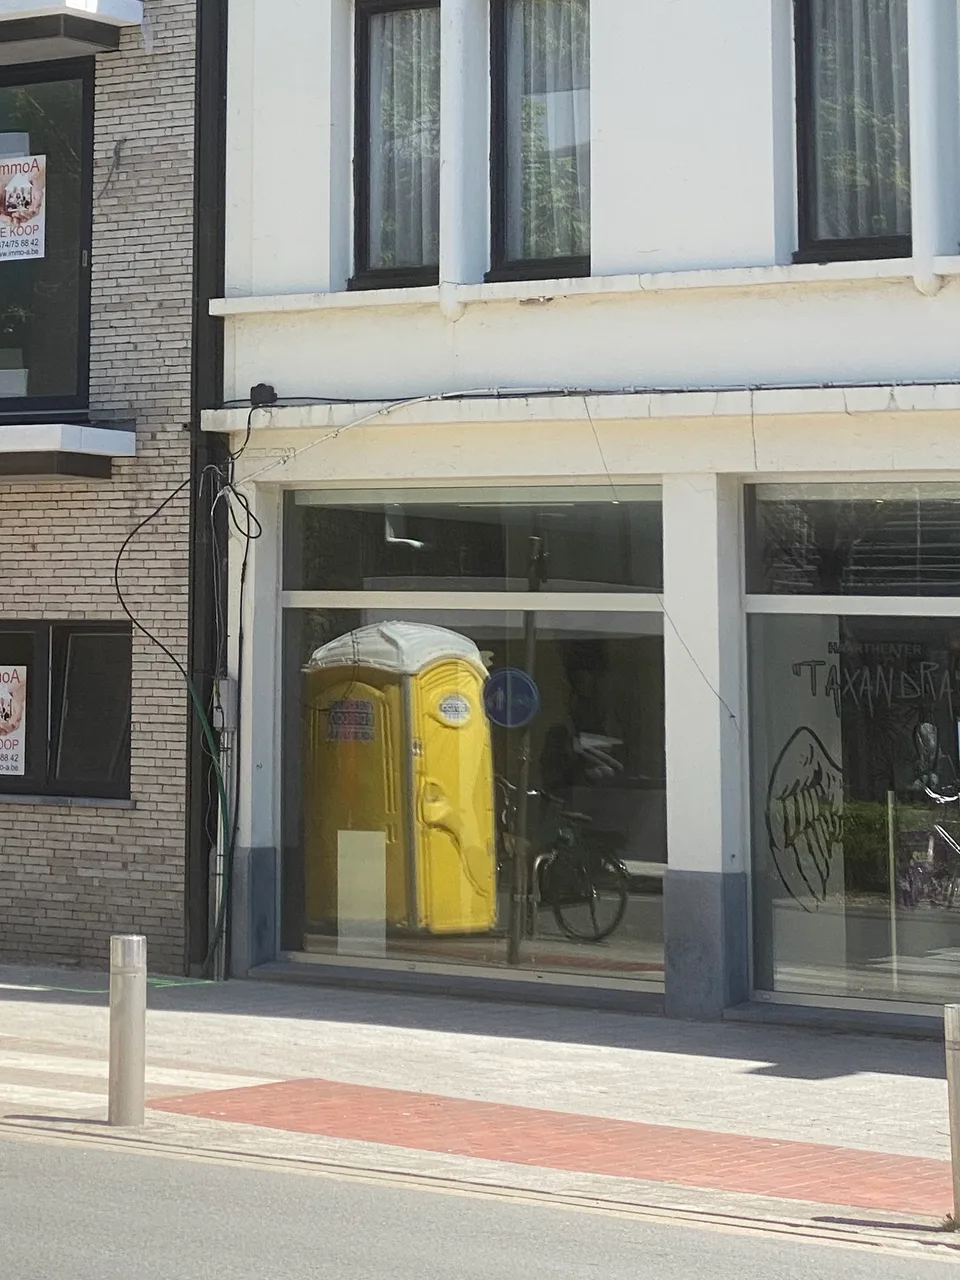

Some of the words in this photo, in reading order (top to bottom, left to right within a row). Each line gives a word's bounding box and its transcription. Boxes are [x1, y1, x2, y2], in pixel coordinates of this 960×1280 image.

[10, 225, 39, 237] KOOP
[30, 238, 39, 246] 42
[0, 753, 8, 761] 88
[10, 754, 19, 762] 42
